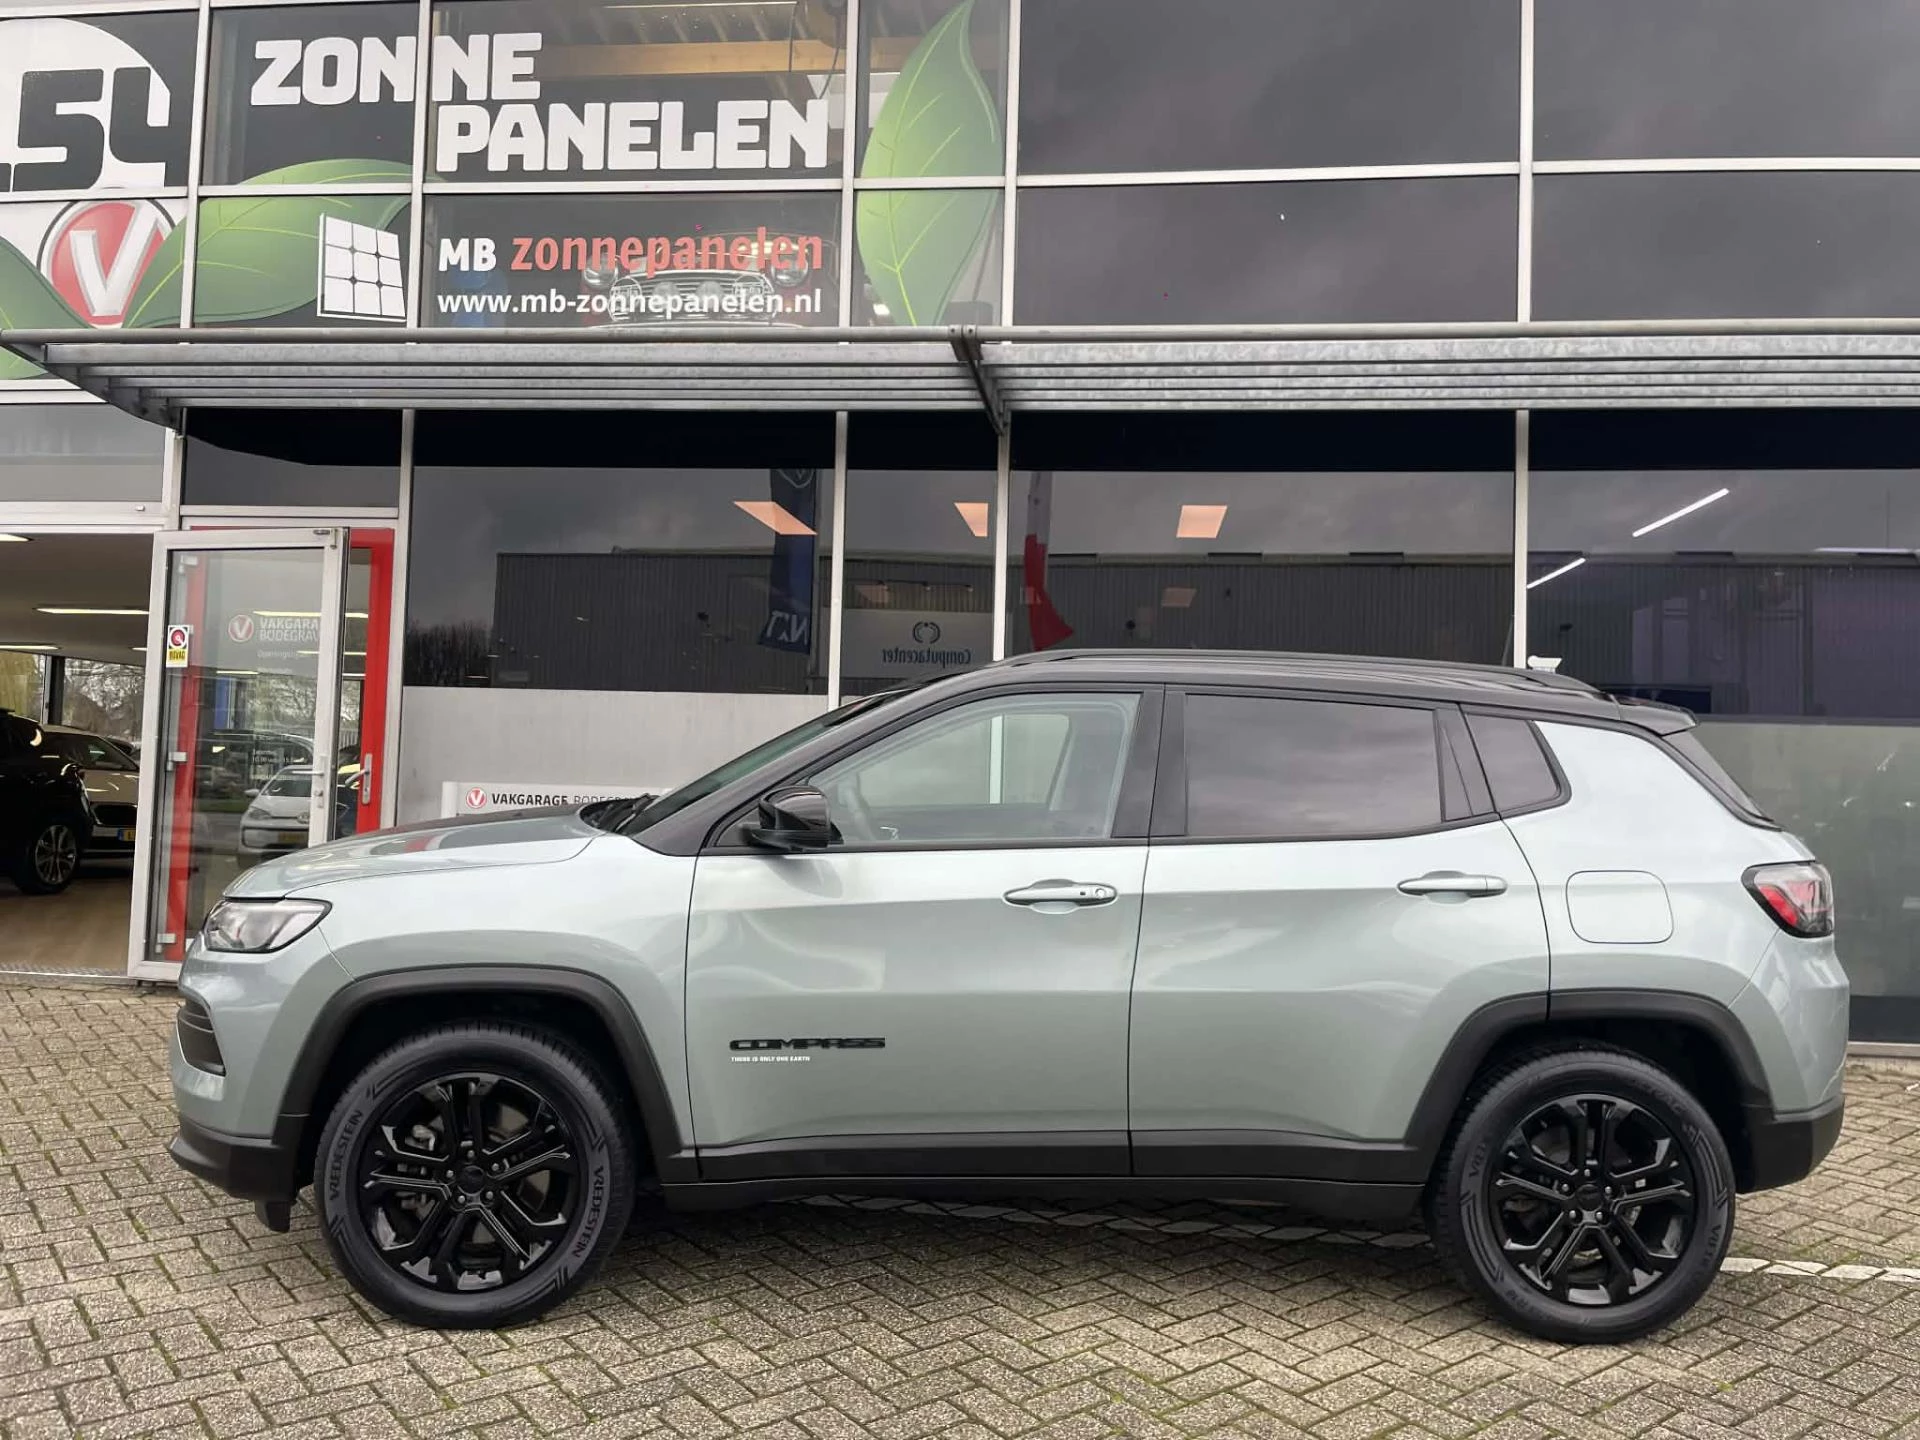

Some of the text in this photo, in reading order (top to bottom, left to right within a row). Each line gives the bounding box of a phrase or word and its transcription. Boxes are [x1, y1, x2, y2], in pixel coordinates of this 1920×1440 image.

[250, 32, 543, 106] ZONNE
[0, 67, 189, 192] 54
[436, 98, 829, 172] PANELEN
[439, 226, 823, 278] MB zonnepanelen
[438, 288, 822, 321] www.mb-zonnepanelen.nl
[492, 793, 568, 807] VAKGARAGE
[729, 1037, 886, 1051] COMPASS
[328, 1109, 364, 1202] VREDESTEIN
[571, 1165, 605, 1259] VREDESTEIN
